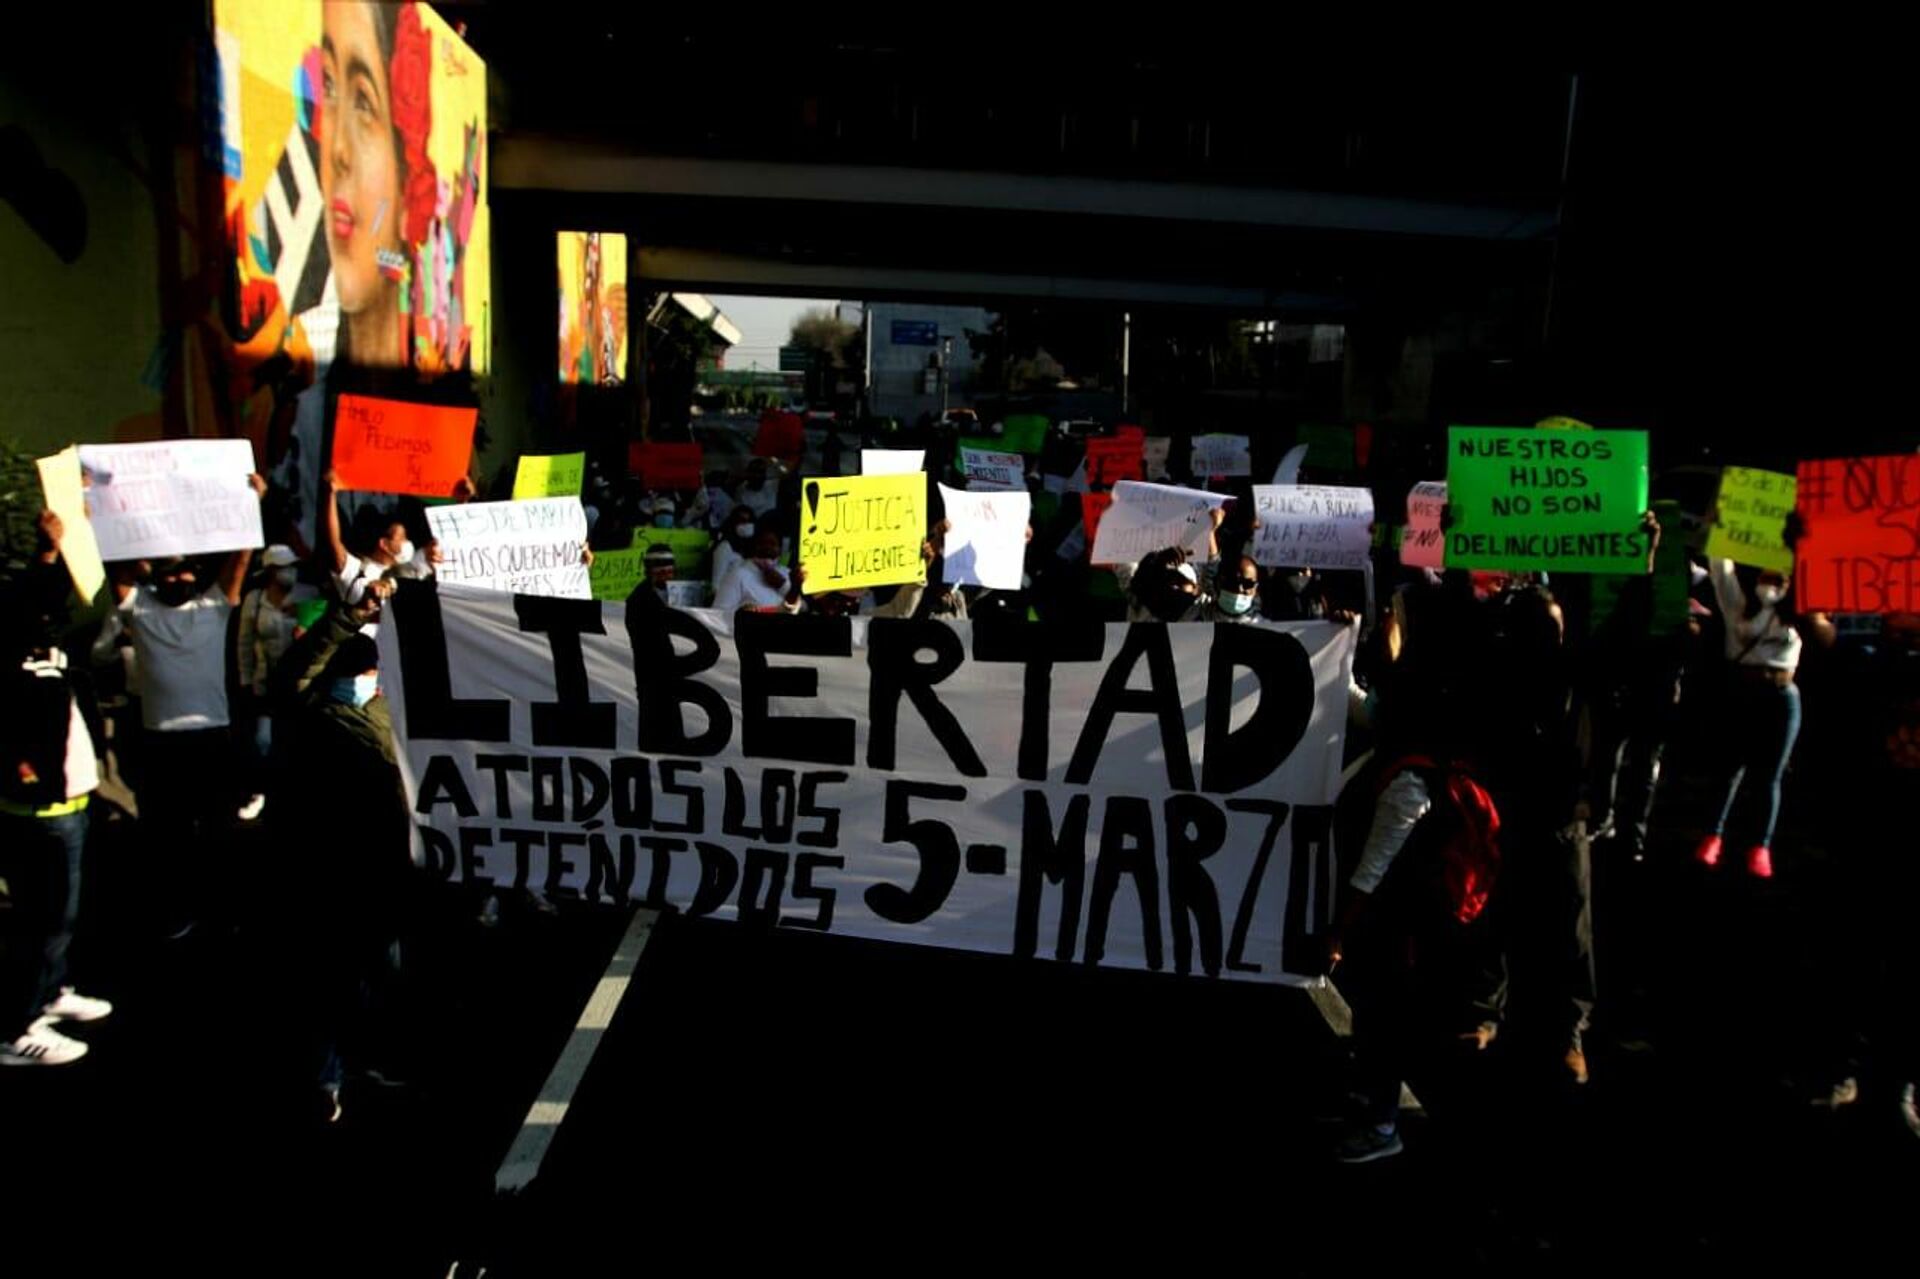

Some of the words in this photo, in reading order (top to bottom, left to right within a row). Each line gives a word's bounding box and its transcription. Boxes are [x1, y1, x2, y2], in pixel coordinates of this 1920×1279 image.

[1459, 438, 1613, 460] NUESTROS
[1510, 466, 1588, 488] HIJOS
[1491, 495, 1532, 516] NO
[1542, 492, 1603, 516] SON
[498, 539, 583, 575] QUEREMO
[802, 537, 827, 557] SON
[1453, 532, 1643, 558] DELINCUENTES
[391, 578, 1315, 793] LIBERTAD
[416, 755, 478, 816] A
[476, 754, 704, 834] TODOS
[722, 766, 848, 848] LOS
